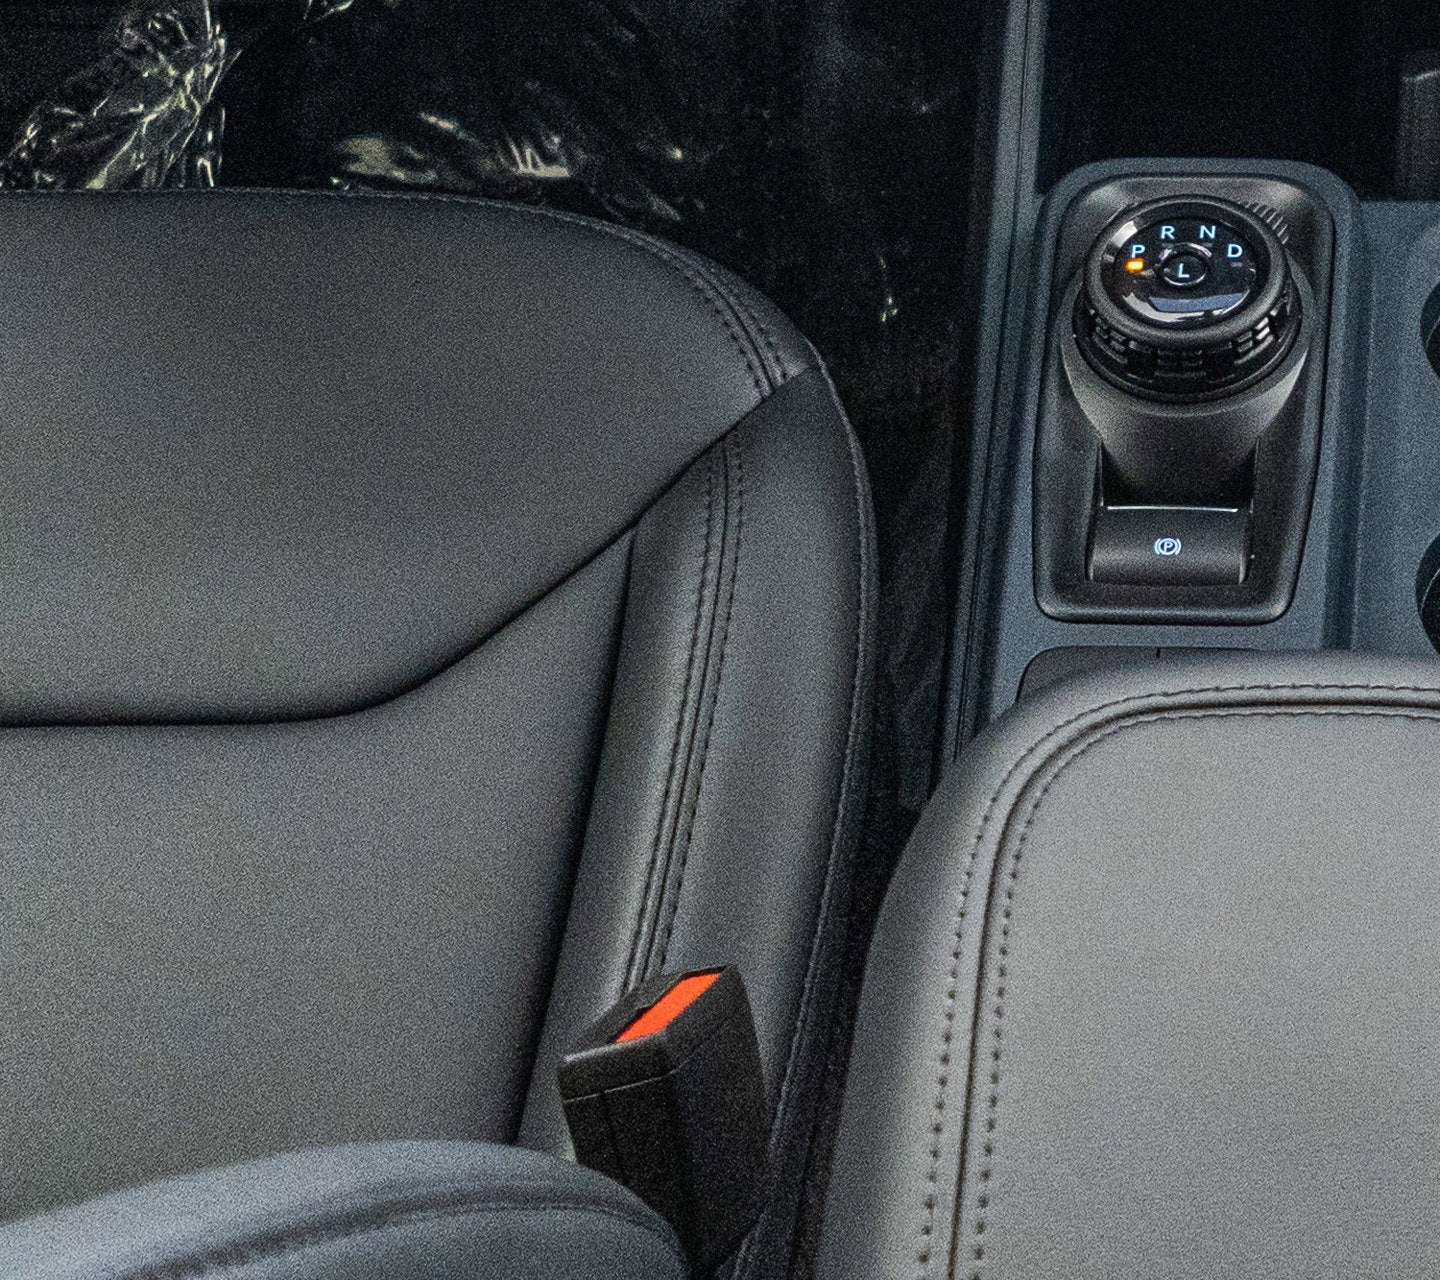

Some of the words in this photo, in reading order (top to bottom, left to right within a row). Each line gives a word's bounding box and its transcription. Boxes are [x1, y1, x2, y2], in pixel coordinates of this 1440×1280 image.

[1160, 225, 1175, 239] R
[1199, 225, 1216, 239] N
[1131, 244, 1146, 258] P
[1227, 243, 1243, 258] D
[1177, 262, 1190, 278] L
